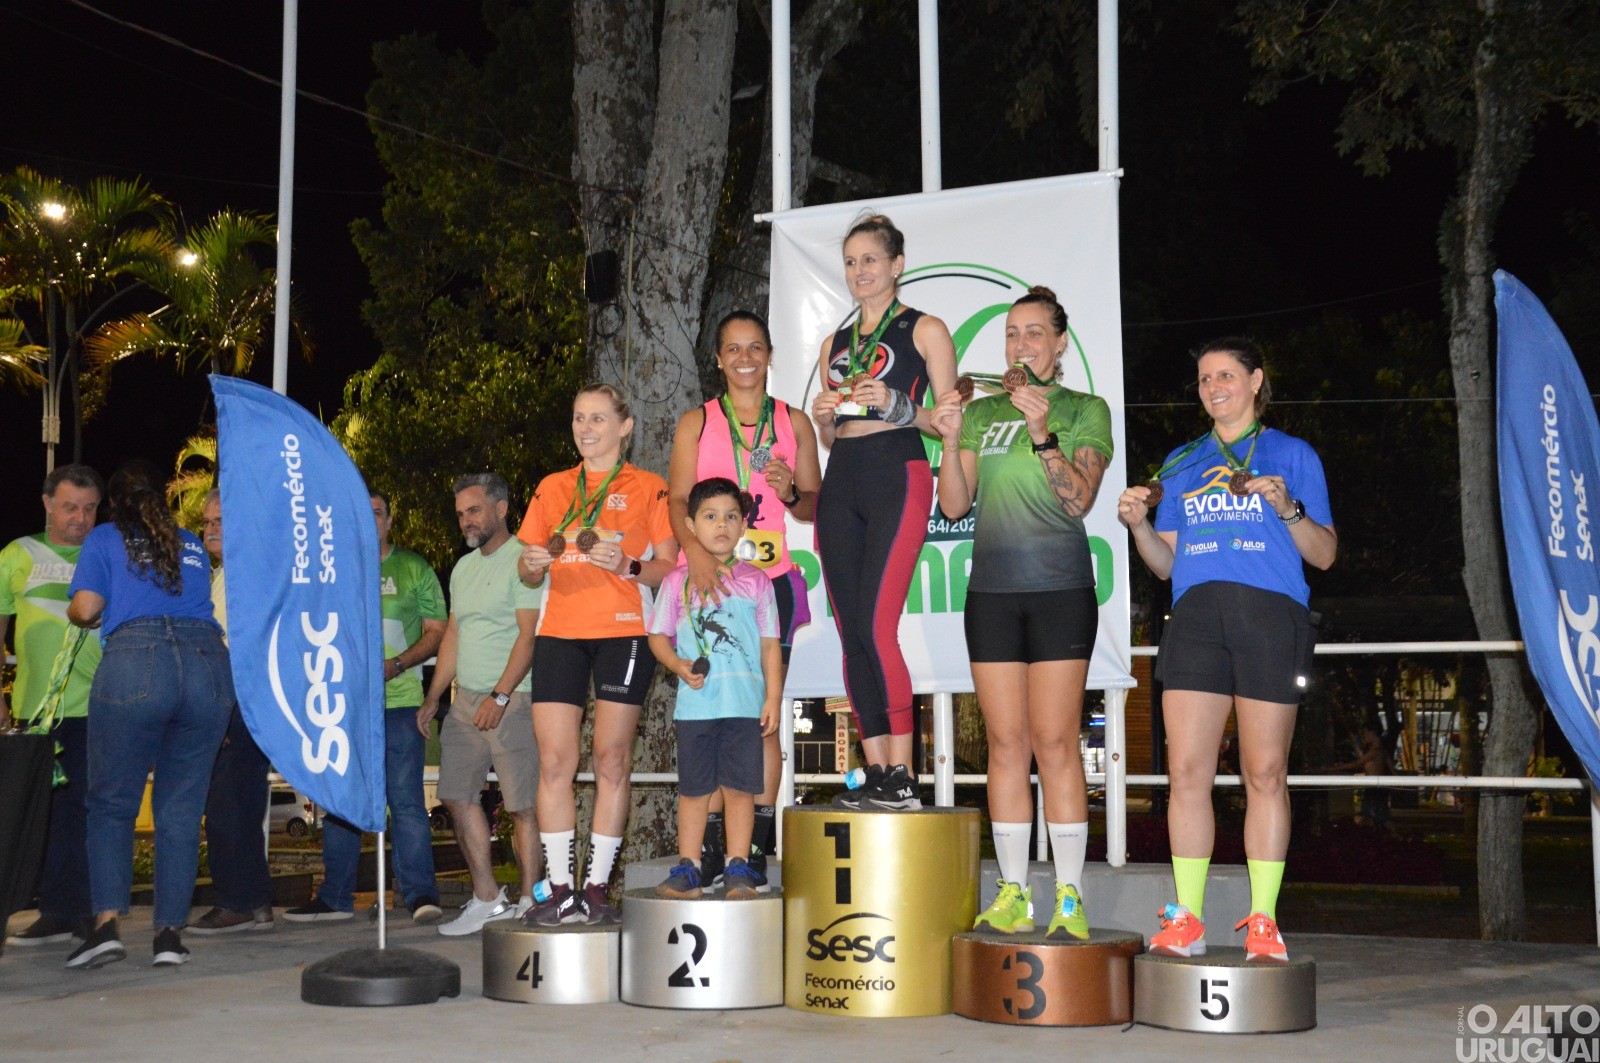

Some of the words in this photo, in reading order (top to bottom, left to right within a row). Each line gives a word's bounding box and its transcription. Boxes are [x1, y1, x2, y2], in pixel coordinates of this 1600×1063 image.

[981, 420, 1027, 448] FIT
[1540, 383, 1568, 558] Fecomércio
[280, 433, 311, 584] Fecomércio
[1184, 493, 1263, 516] EVOLUA
[1187, 516, 1198, 526] EM
[1201, 511, 1264, 523] MOVIMENTO
[1570, 469, 1594, 562] Senac
[315, 504, 336, 584] Senac
[1191, 541, 1218, 552] EVOLUA
[1243, 541, 1266, 549] AILOS
[299, 611, 350, 777] Sesc
[824, 822, 852, 904] 1
[667, 923, 710, 988] 2
[806, 926, 896, 963] Sesc
[516, 951, 543, 989] 4
[805, 972, 896, 992] Fecomércio
[1003, 951, 1047, 1020] 3
[805, 993, 850, 1010] Senac
[1199, 979, 1230, 1020] 5
